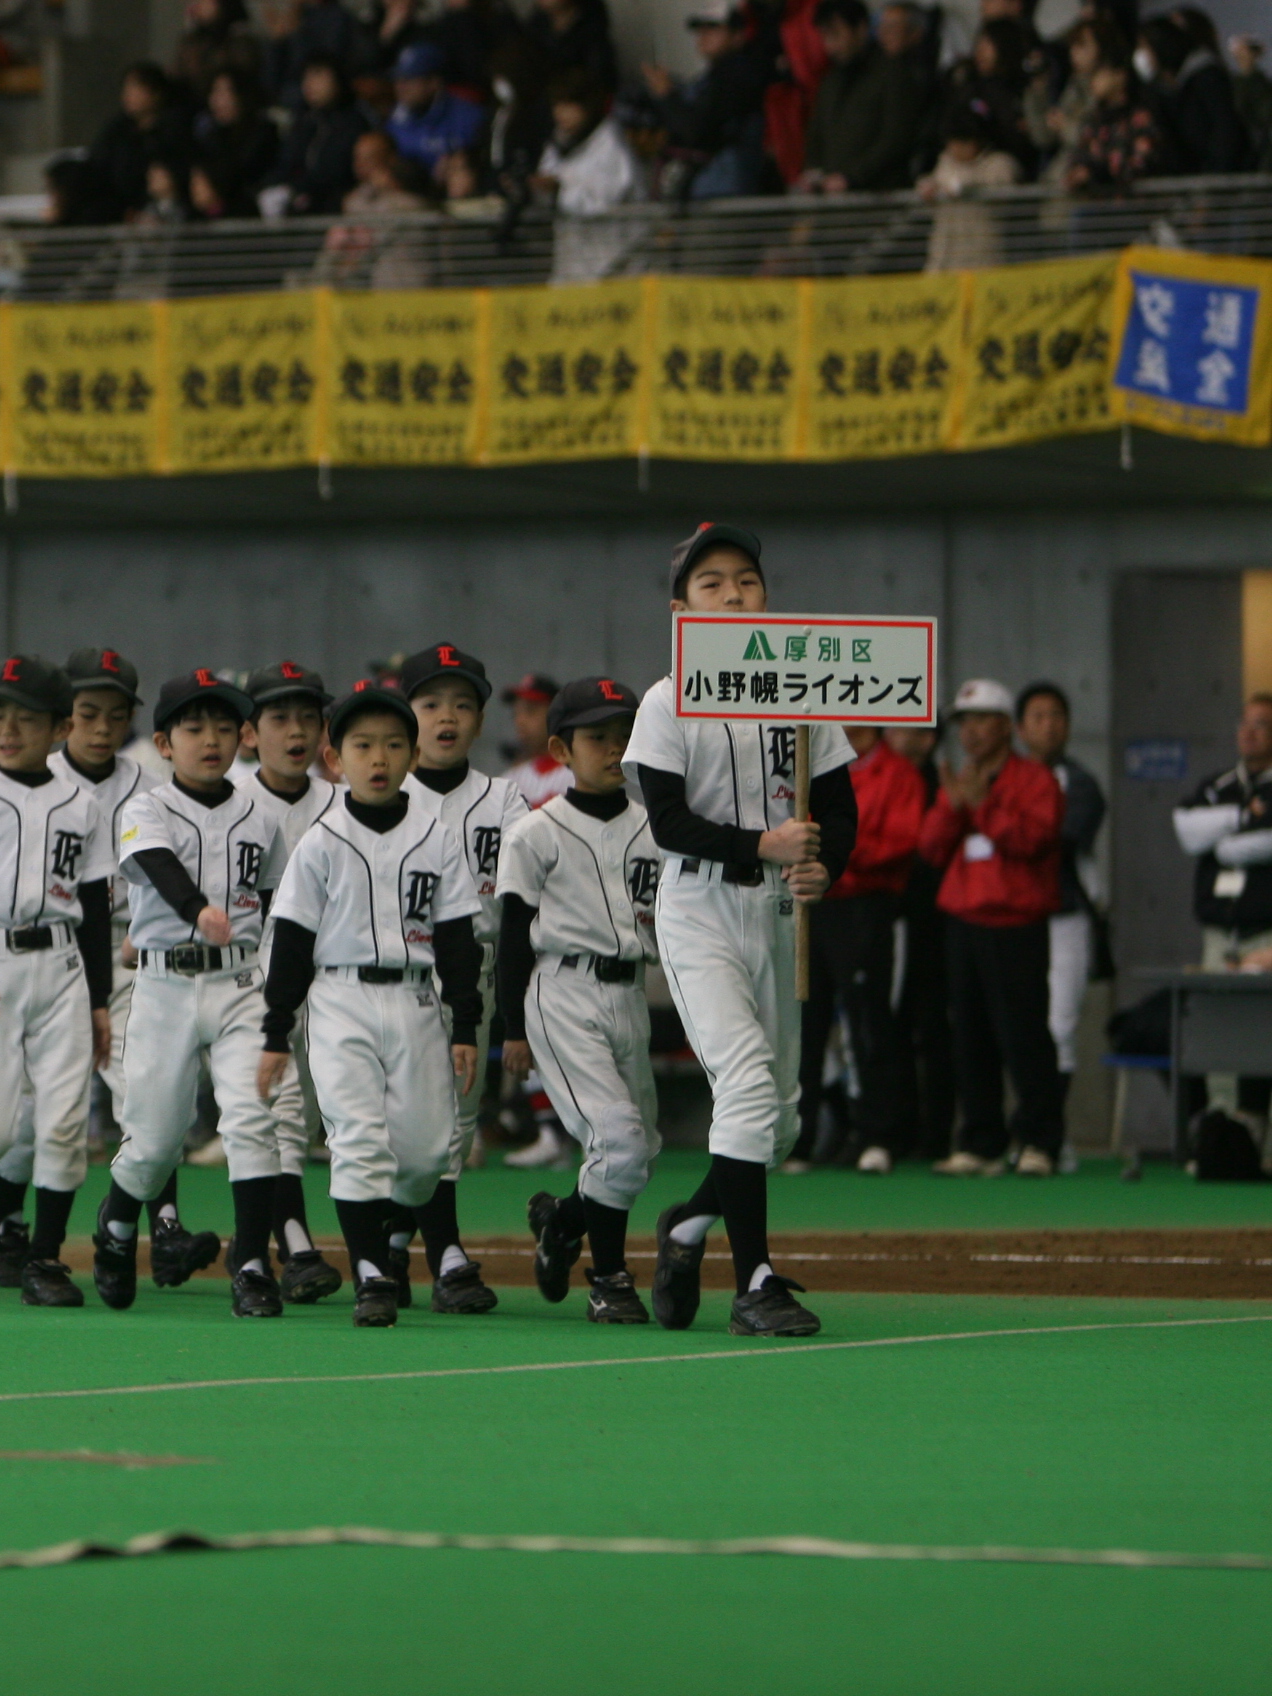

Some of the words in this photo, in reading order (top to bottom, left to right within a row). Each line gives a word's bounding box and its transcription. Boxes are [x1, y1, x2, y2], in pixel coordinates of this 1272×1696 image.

[784, 635, 872, 663] 厚別区
[684, 669, 923, 706] 小野幌ライオンズ
